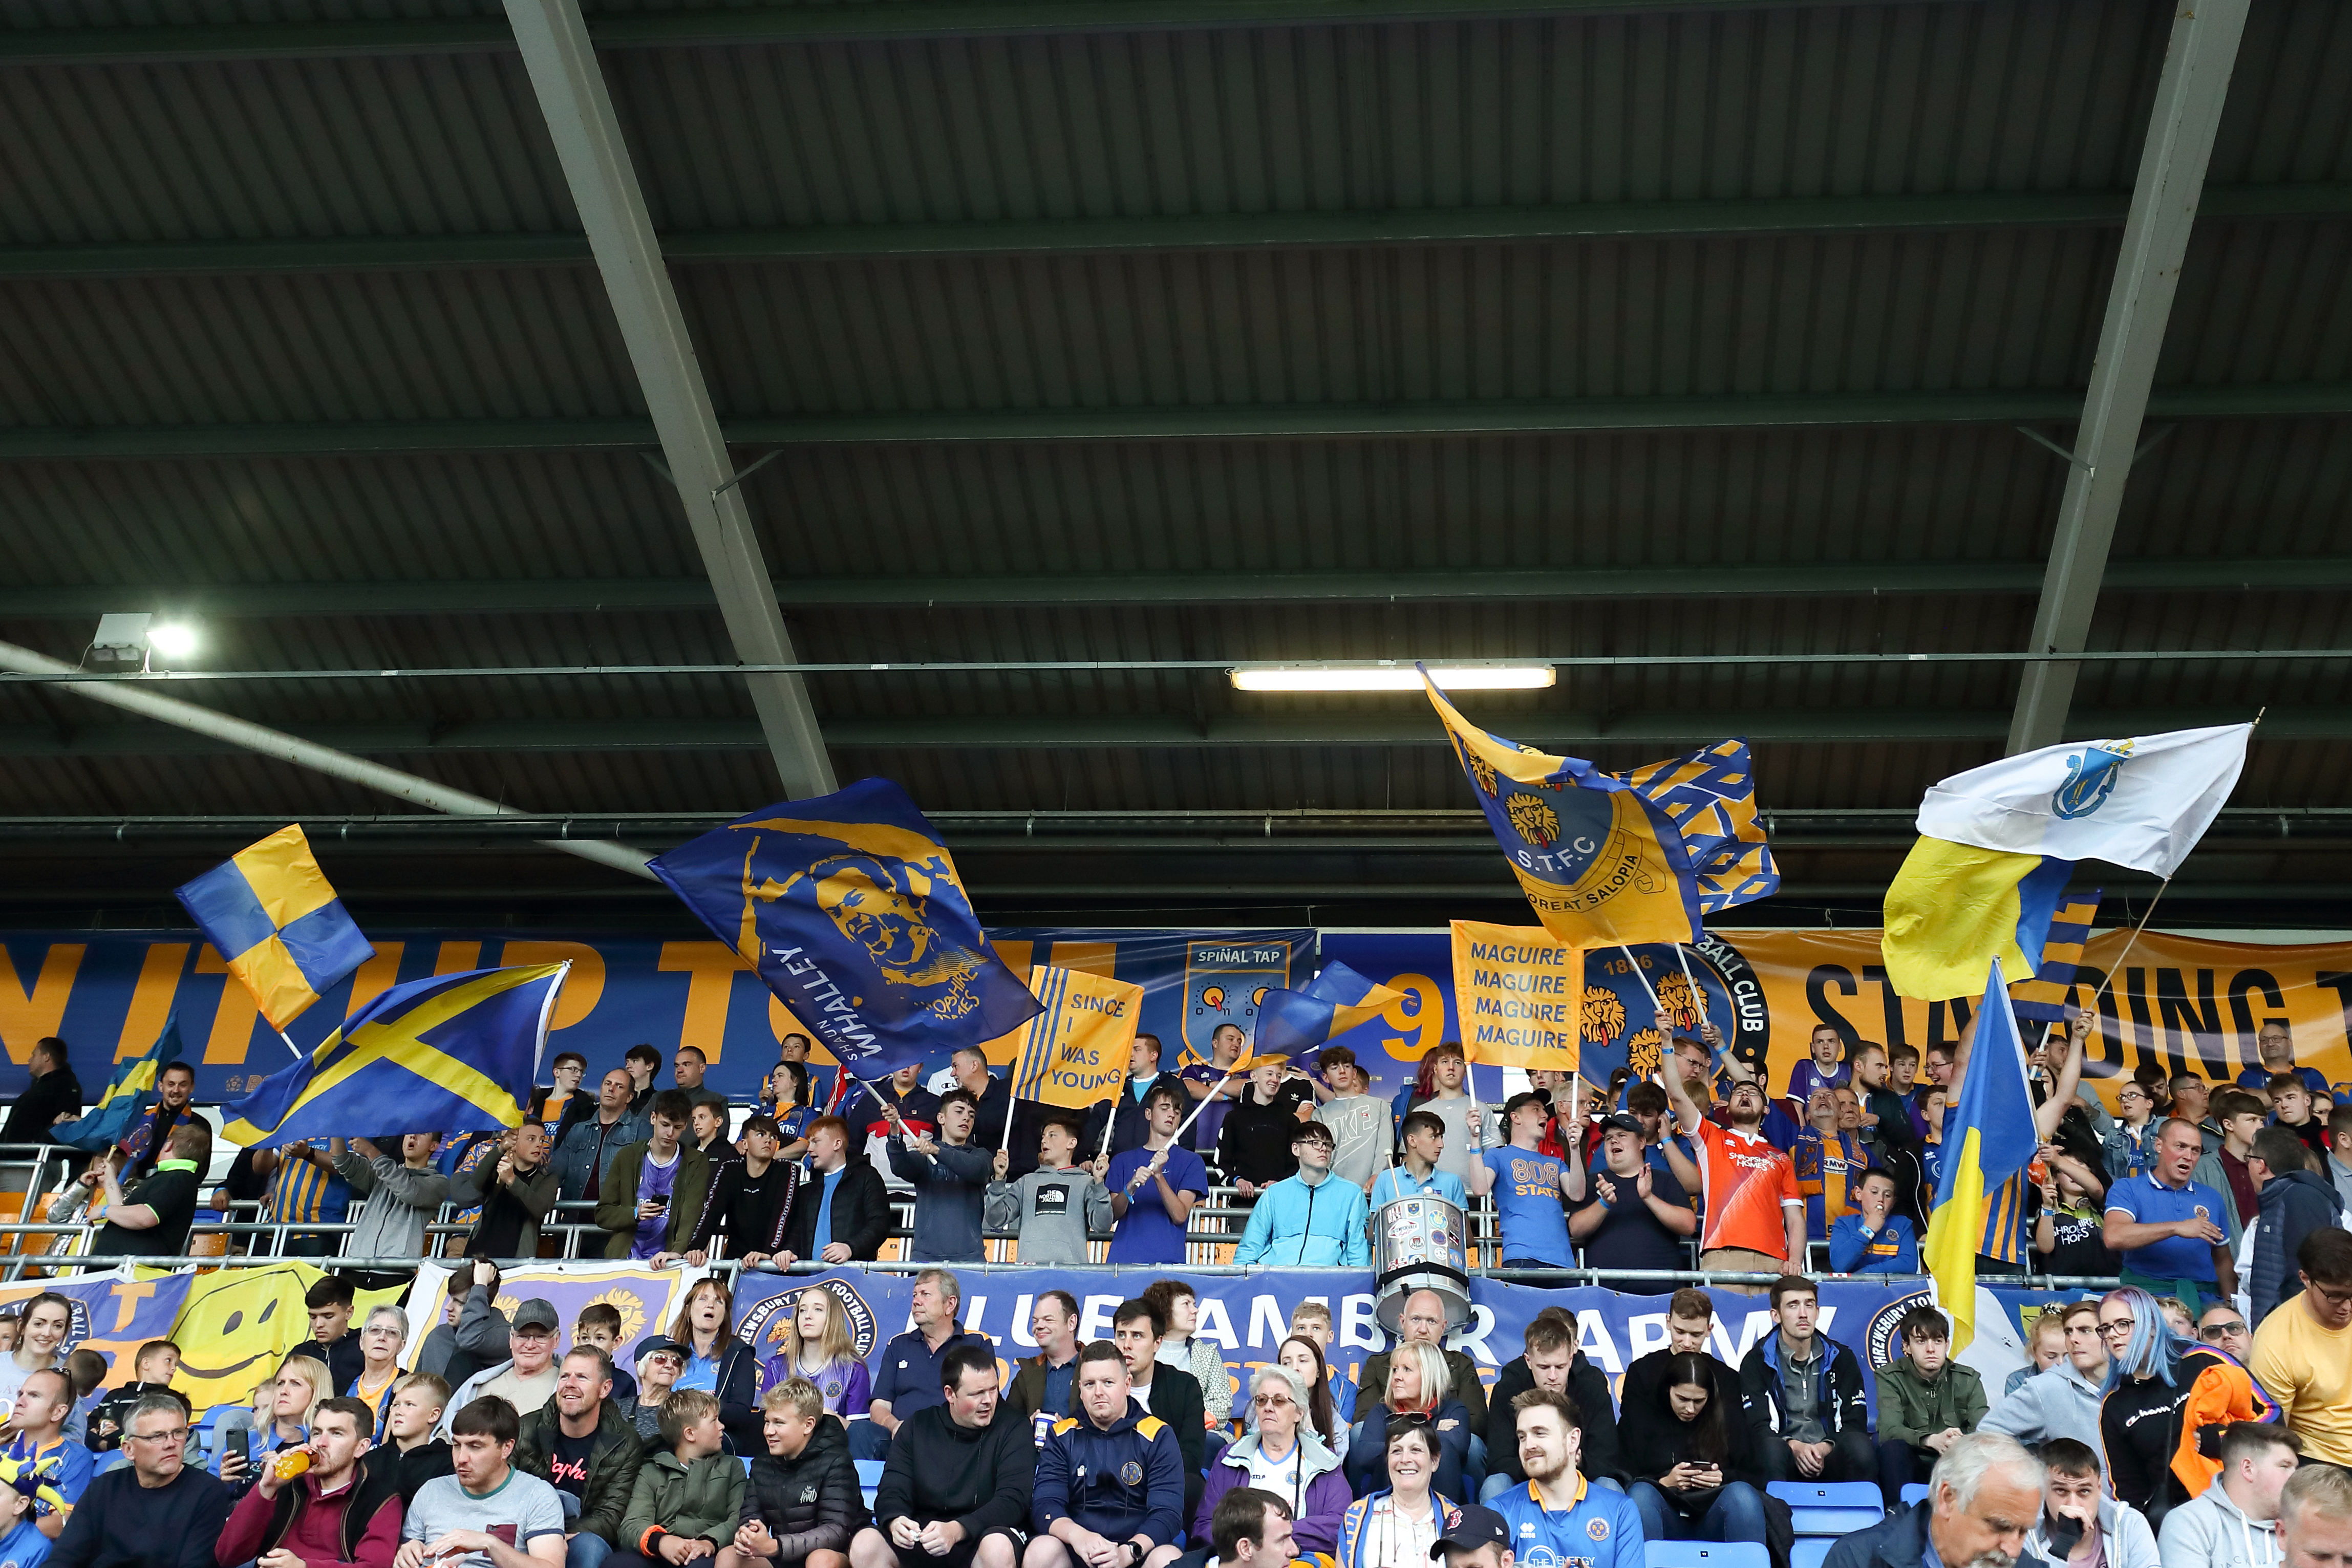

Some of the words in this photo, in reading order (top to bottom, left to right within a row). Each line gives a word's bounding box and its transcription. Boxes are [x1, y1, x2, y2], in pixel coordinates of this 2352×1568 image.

[1517, 836, 1595, 872] S.T.F.C
[1587, 855, 1638, 904] SALOPIA
[1253, 951, 1280, 963] TAP
[1471, 942, 1567, 965] MAGUIRE
[1473, 969, 1567, 994] MAGUIRE
[771, 947, 883, 1058] WHALLEY
[1071, 993, 1125, 1017] SINCE
[1476, 996, 1567, 1023] MAGUIRE
[1734, 980, 1764, 1032] CLUB
[1066, 1016, 1073, 1033] I
[1381, 973, 1444, 1062] 9
[1806, 963, 2296, 1081] STDING
[817, 1019, 858, 1061] SHAUN
[1476, 1024, 1568, 1049] MAGUIRE
[1061, 1043, 1100, 1065] WAS
[1052, 1069, 1121, 1090] YOUNG
[1511, 1158, 1559, 1188] 808
[1728, 1152, 1776, 1170] SHROPSHIRE
[1737, 1159, 1767, 1171] HOMES
[1515, 1184, 1560, 1202] STATE
[740, 1295, 792, 1345] REWSBURY
[831, 1283, 870, 1333] FOOTBALL
[906, 1294, 1125, 1346] LUE
[1191, 1294, 1501, 1366] AMBR
[1872, 1304, 1908, 1368] HREWSBURY
[2126, 1392, 2190, 1427] Chamio
[1531, 1558, 1549, 1566] THE
